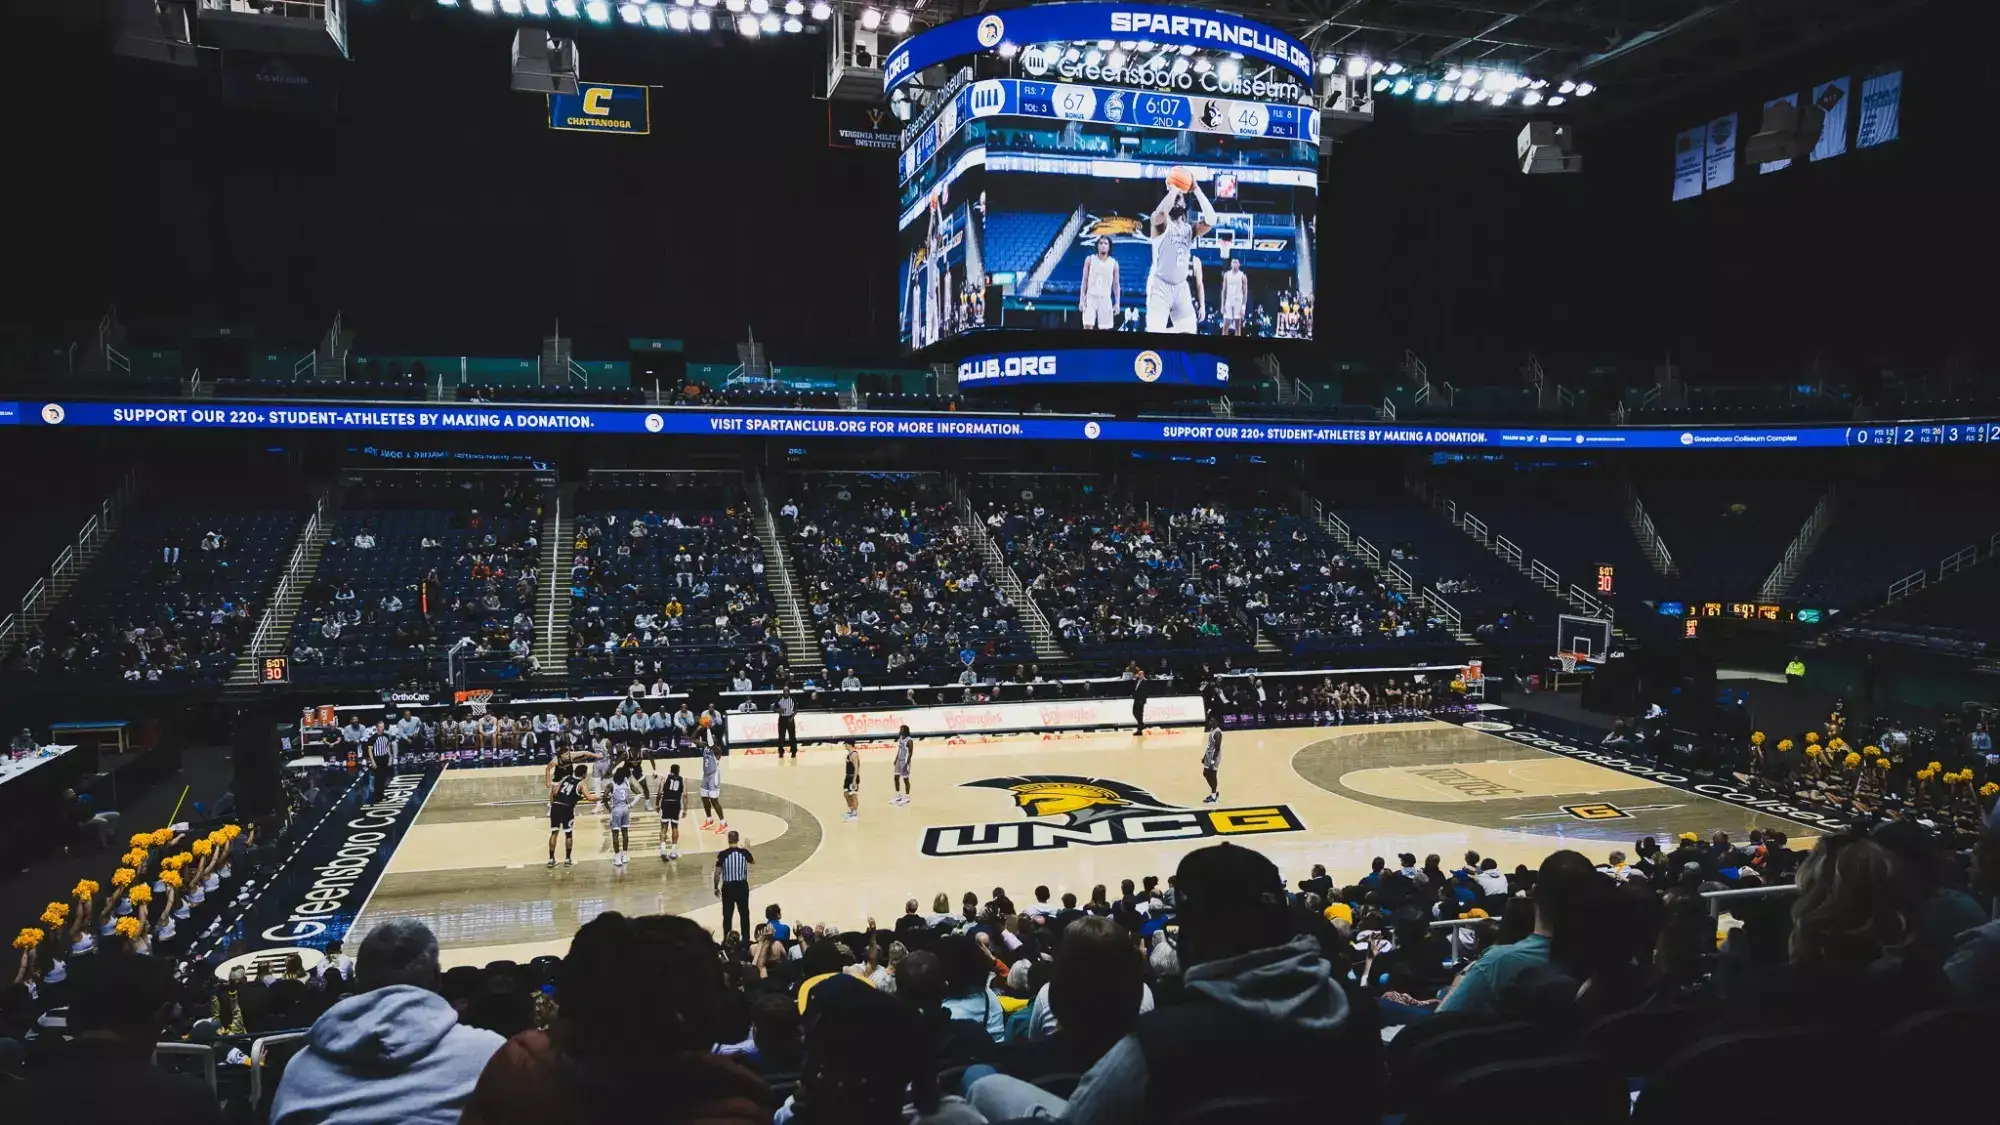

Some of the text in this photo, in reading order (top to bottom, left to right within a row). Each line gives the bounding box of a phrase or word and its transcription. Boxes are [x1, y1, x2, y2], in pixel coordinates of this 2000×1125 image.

[1111, 12, 1310, 76] SPARTANCLUB.ORG
[1060, 61, 1300, 99] Greensboro Coliseum
[1024, 87, 1037, 95] FLS:
[583, 88, 613, 115] C
[1024, 103, 1047, 112] TOL: 3
[1064, 93, 1085, 110] 67
[1146, 97, 1180, 116] 6:07
[1065, 112, 1085, 120] BONUS
[1238, 110, 1259, 126] 46
[1273, 110, 1292, 119] FLS: 8
[567, 117, 632, 128] CHATTANOOGA
[1153, 116, 1173, 126] 2ND
[839, 129, 873, 139] VIRGINIA
[855, 139, 897, 149] INSTITUTE
[114, 408, 594, 428] SUPPORT OUR 220+ STUDENT-ATHLETES BY MAKING A DONATION.
[711, 418, 1023, 435] VISIT SPARTANCLUB.ORG FOR MORE INFORMATION.
[1886, 428, 1894, 436] 13
[1163, 426, 1488, 443] SUPPORT OUR 220+ STUDENT-ATHLETES BY MAKING A DONATION.
[1694, 435, 1732, 443] Greensboro
[1766, 434, 1797, 443] Complex
[1857, 430, 1868, 443] 0
[1886, 436, 1891, 444] 2
[1904, 429, 1914, 443] 2
[1949, 427, 1958, 441] 3
[1978, 434, 1984, 442] 2
[1599, 566, 1613, 576] 6:07
[1598, 576, 1611, 591] 30
[1708, 608, 1720, 616] 67
[1734, 604, 1755, 613] 6:07
[1764, 611, 1776, 619] 46
[267, 659, 285, 667] 6:07
[267, 668, 281, 679] 30
[392, 692, 430, 701] OrthoCare
[943, 710, 1003, 729] Bojangles
[1504, 731, 1688, 783] Greensboro
[561, 782, 574, 796] 24
[669, 778, 680, 791] 10
[620, 789, 626, 800] 3
[347, 774, 425, 828] Coliseum
[921, 804, 1307, 856] UNCG
[262, 832, 387, 942] Greensboro
